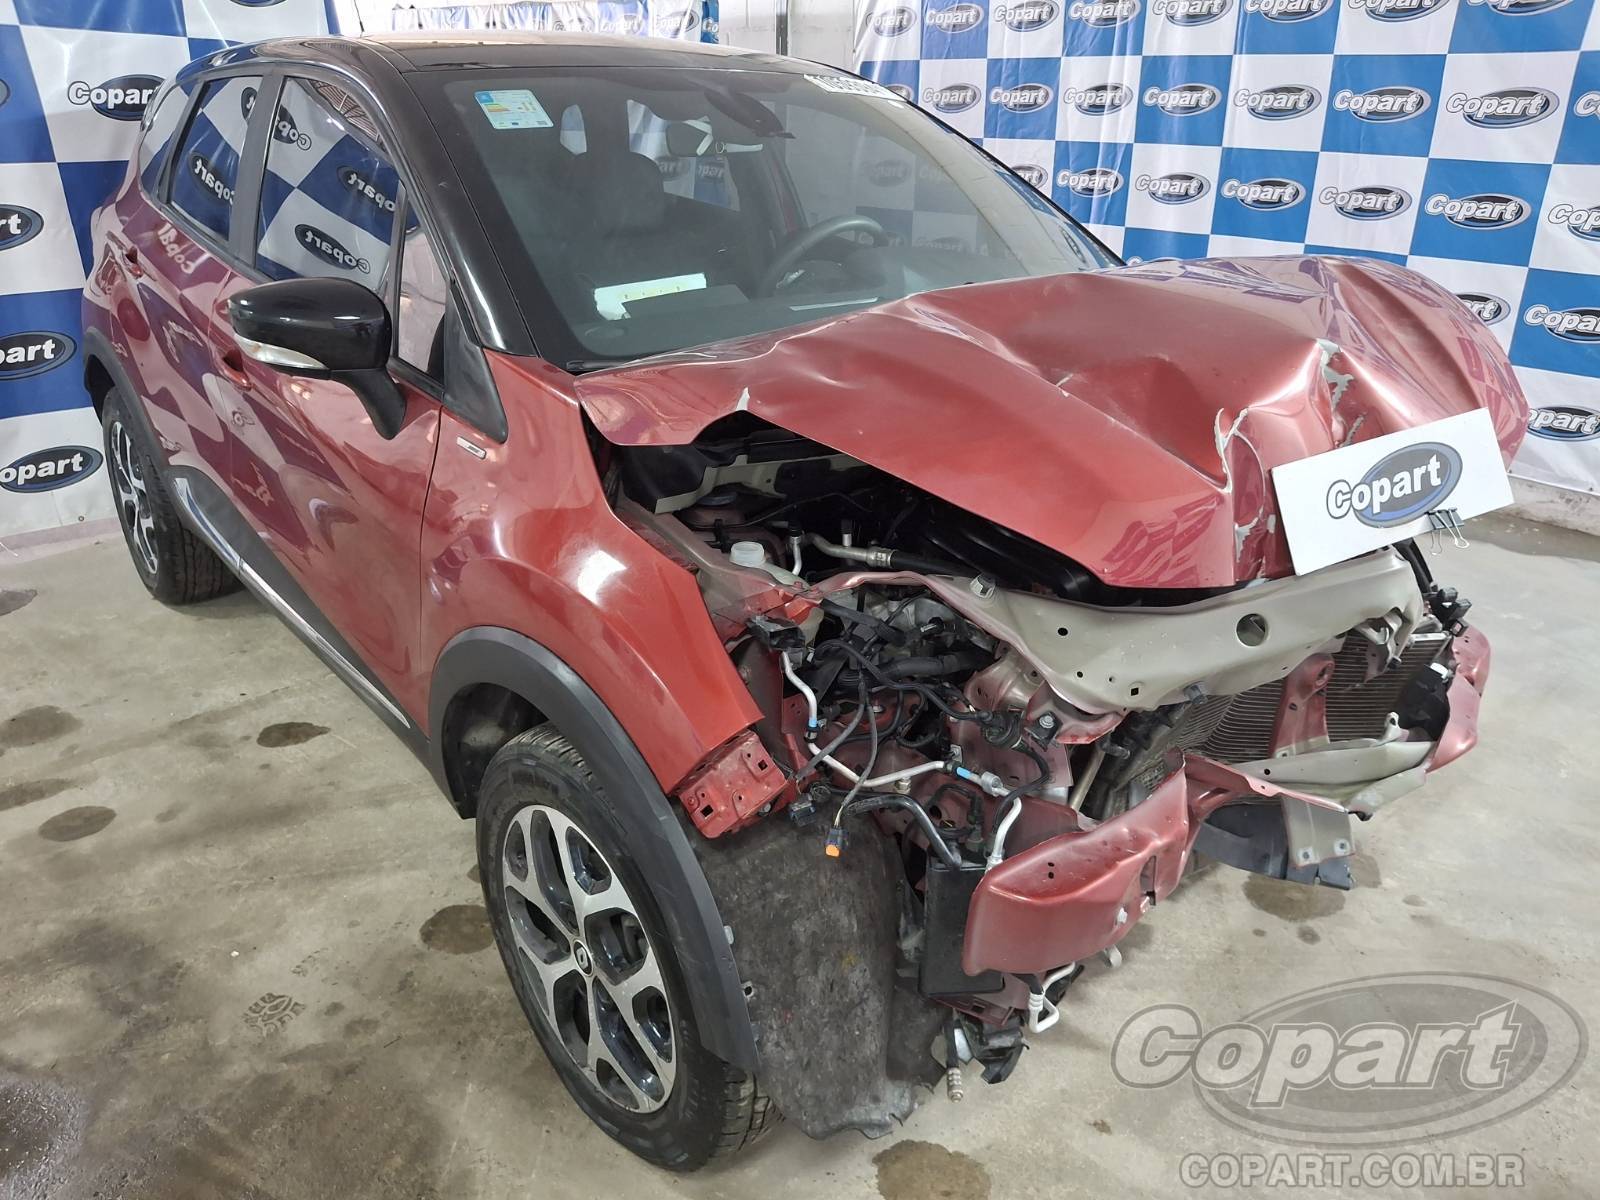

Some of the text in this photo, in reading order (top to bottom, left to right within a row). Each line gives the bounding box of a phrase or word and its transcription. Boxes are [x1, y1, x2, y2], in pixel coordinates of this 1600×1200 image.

[925, 9, 978, 28] Copart
[994, 3, 1051, 26] Copart
[1069, 1, 1133, 25] Copart
[1152, 0, 1222, 20] Copart
[1245, 0, 1322, 17] Copart
[67, 80, 158, 110] Copar
[923, 87, 976, 106] Copart
[990, 87, 1045, 107] Copart
[1064, 88, 1123, 109] Copart
[1143, 87, 1213, 110] Copart
[1233, 89, 1312, 113] Copart
[1333, 90, 1421, 116] Copart
[1446, 93, 1545, 119] Copart
[1057, 169, 1118, 191] Copart
[1135, 174, 1200, 196] Copart
[1222, 179, 1297, 205] Copart
[1319, 187, 1400, 212] Copart
[1425, 194, 1521, 221] Copart
[1524, 304, 1600, 333] Copa
[1326, 453, 1442, 519] Copart
